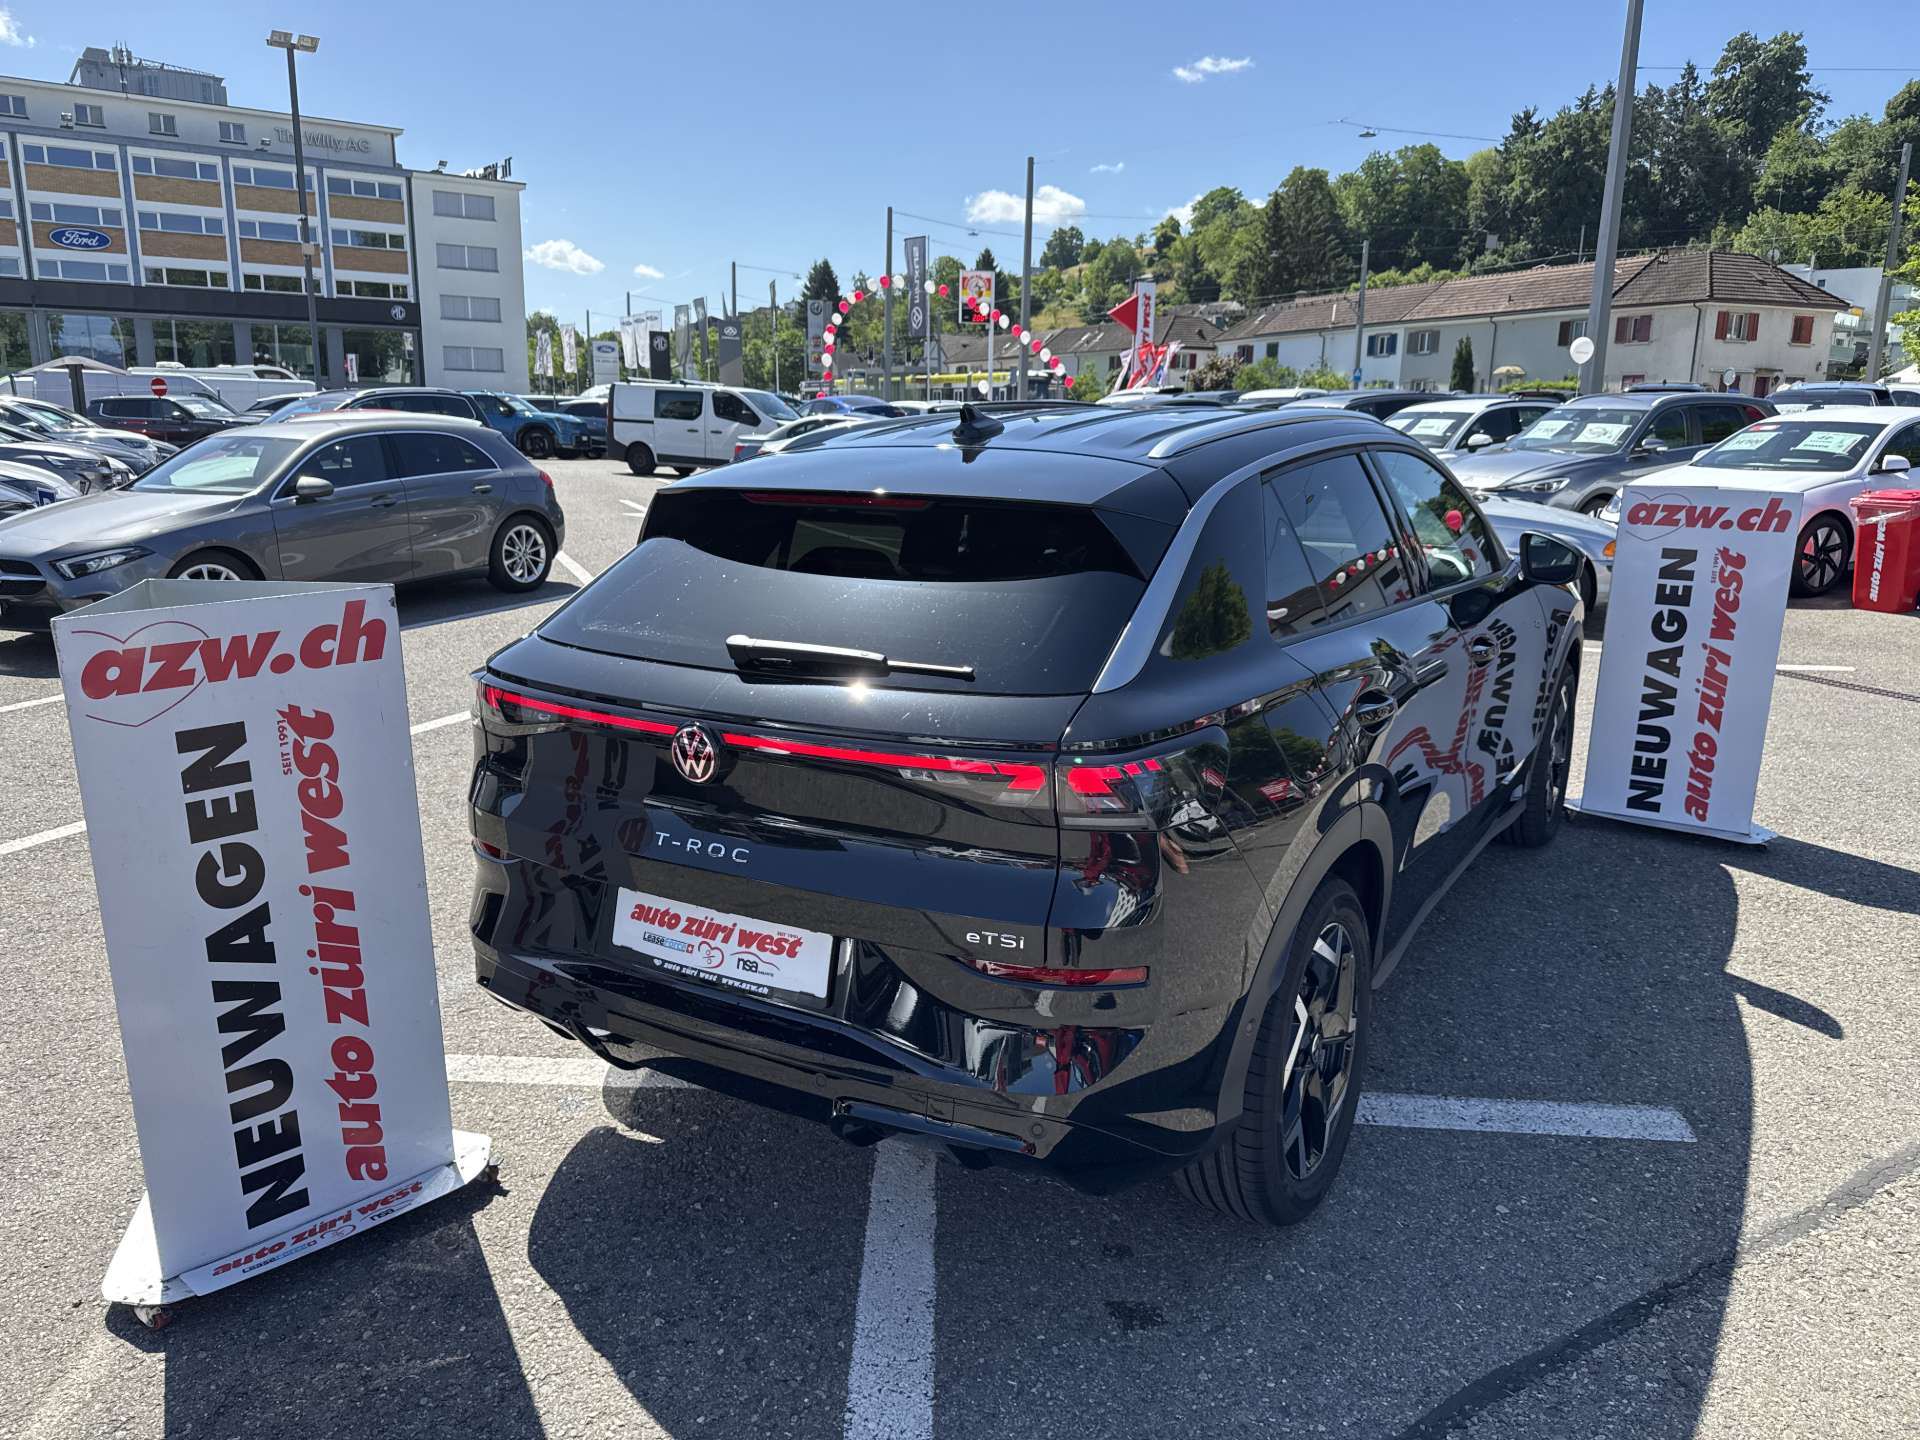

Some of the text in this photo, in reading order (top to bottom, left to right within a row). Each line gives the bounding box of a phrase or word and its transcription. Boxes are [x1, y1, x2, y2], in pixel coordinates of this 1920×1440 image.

[304, 130, 341, 152] Willy
[346, 136, 369, 153] AG
[62, 230, 99, 246] Ford
[1627, 497, 1793, 533] azw.ch
[81, 600, 386, 700] azw.ch
[1626, 547, 1698, 813] NEUWAGEN
[1684, 546, 1747, 822] auto züri west
[276, 719, 293, 776] SEIT 1991
[655, 831, 750, 863] T-ROC
[276, 703, 389, 1182] auto züri west
[630, 903, 804, 959] auto züri west
[966, 931, 1025, 950] eTSi
[174, 720, 310, 1230] NEUWAGEN
[736, 957, 759, 974] nsa
[212, 1239, 286, 1277] auto
[357, 1181, 423, 1215] west
